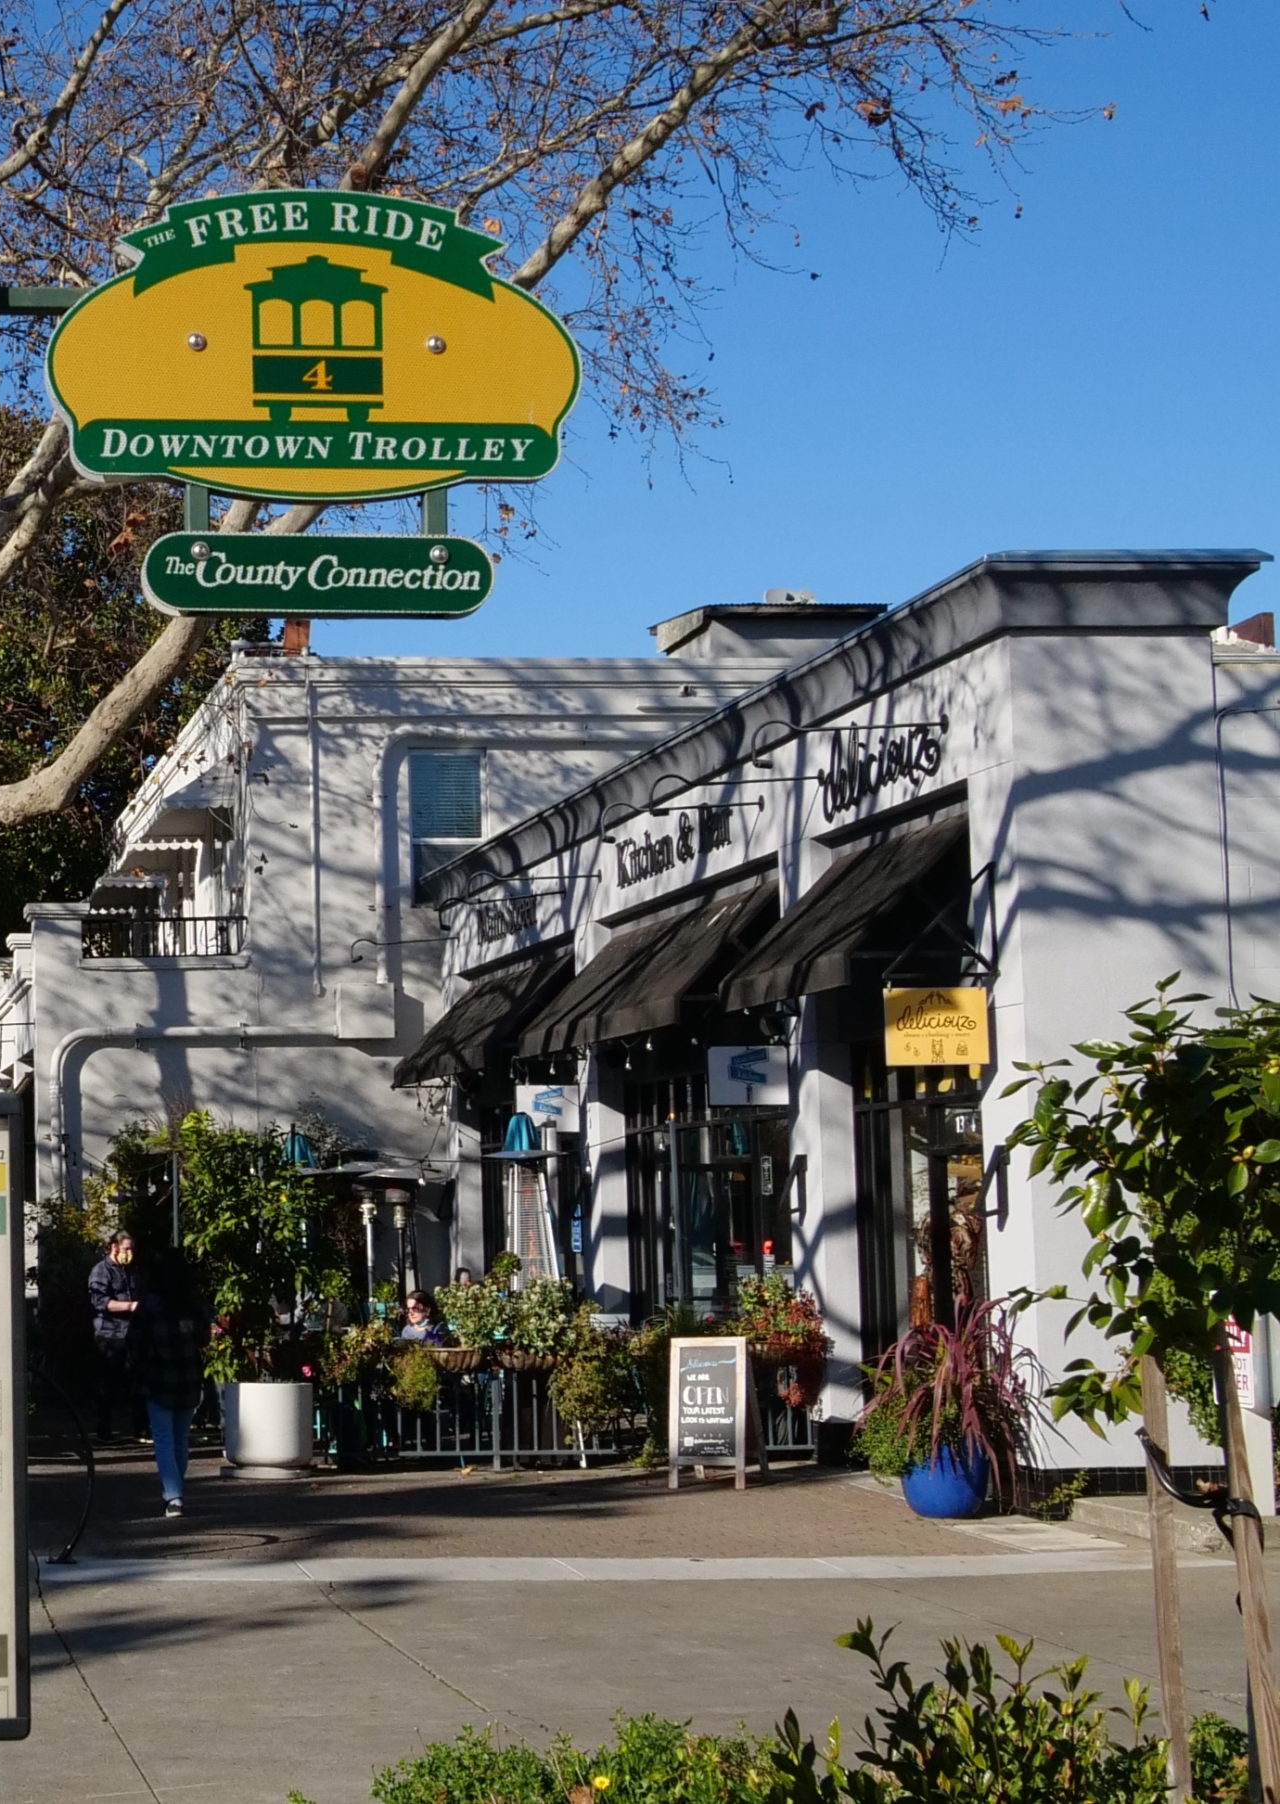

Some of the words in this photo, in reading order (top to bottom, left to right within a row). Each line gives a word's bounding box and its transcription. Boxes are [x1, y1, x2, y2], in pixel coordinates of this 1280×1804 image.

[143, 227, 175, 248] THE
[185, 201, 309, 249] FREE
[330, 201, 447, 252] RIDE
[302, 360, 333, 391] 4
[100, 428, 333, 461] DOWNTOWN
[349, 431, 535, 463] TROLLEY
[165, 556, 195, 577] The
[195, 551, 303, 592] County
[307, 554, 481, 592] Connection
[615, 830, 675, 889] Kitchen
[676, 811, 696, 864] &
[698, 802, 733, 854] Bar
[896, 1005, 977, 1032] deliciouz
[698, 1373, 710, 1381] ARE
[682, 1385, 730, 1405] OPEN
